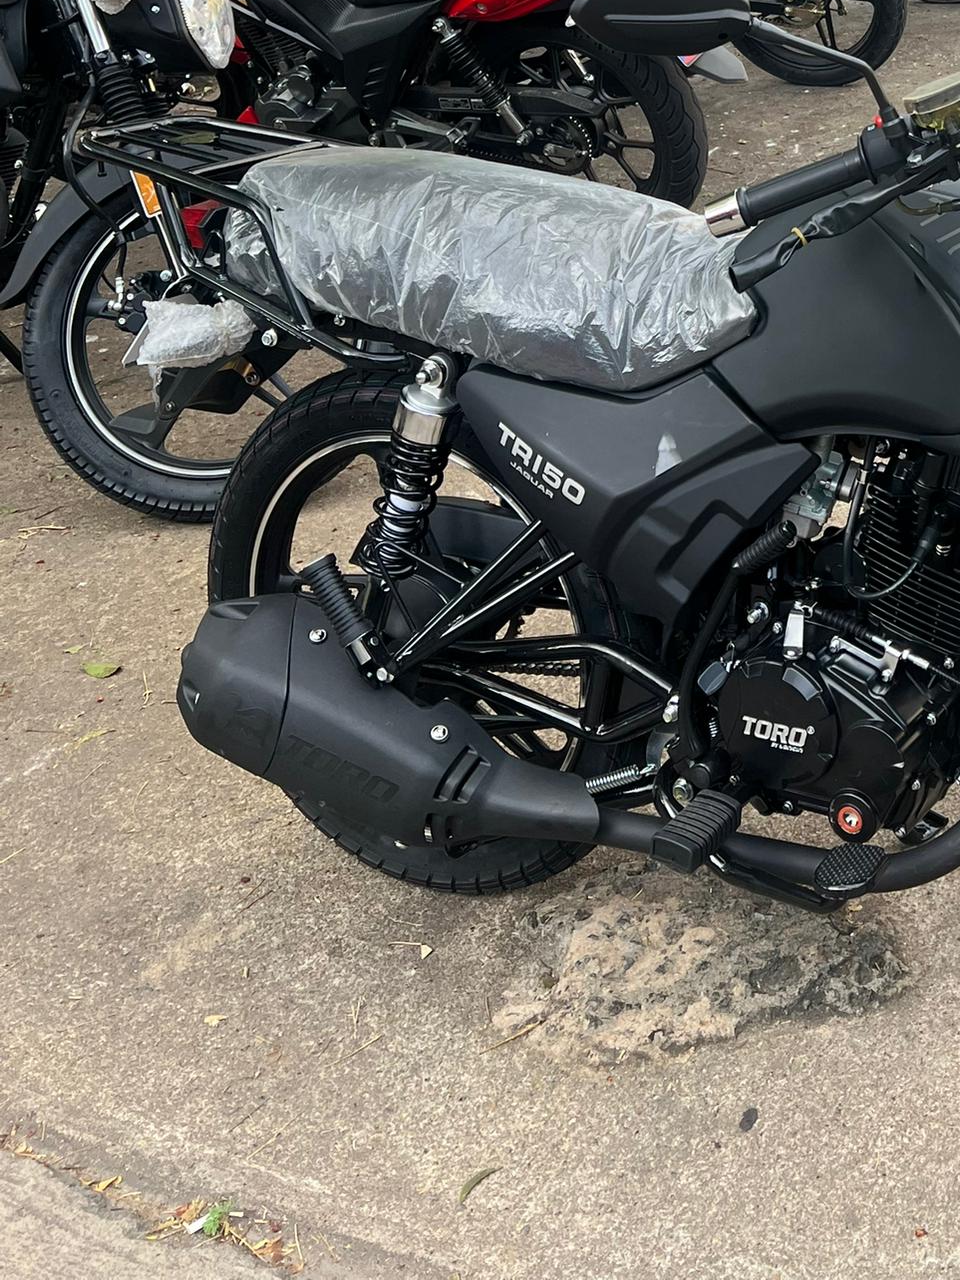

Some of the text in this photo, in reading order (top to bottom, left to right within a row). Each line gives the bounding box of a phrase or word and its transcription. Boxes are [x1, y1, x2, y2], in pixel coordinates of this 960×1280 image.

[498, 421, 586, 506] TR150
[509, 460, 554, 499] JAGUAR
[742, 715, 808, 748] TORO
